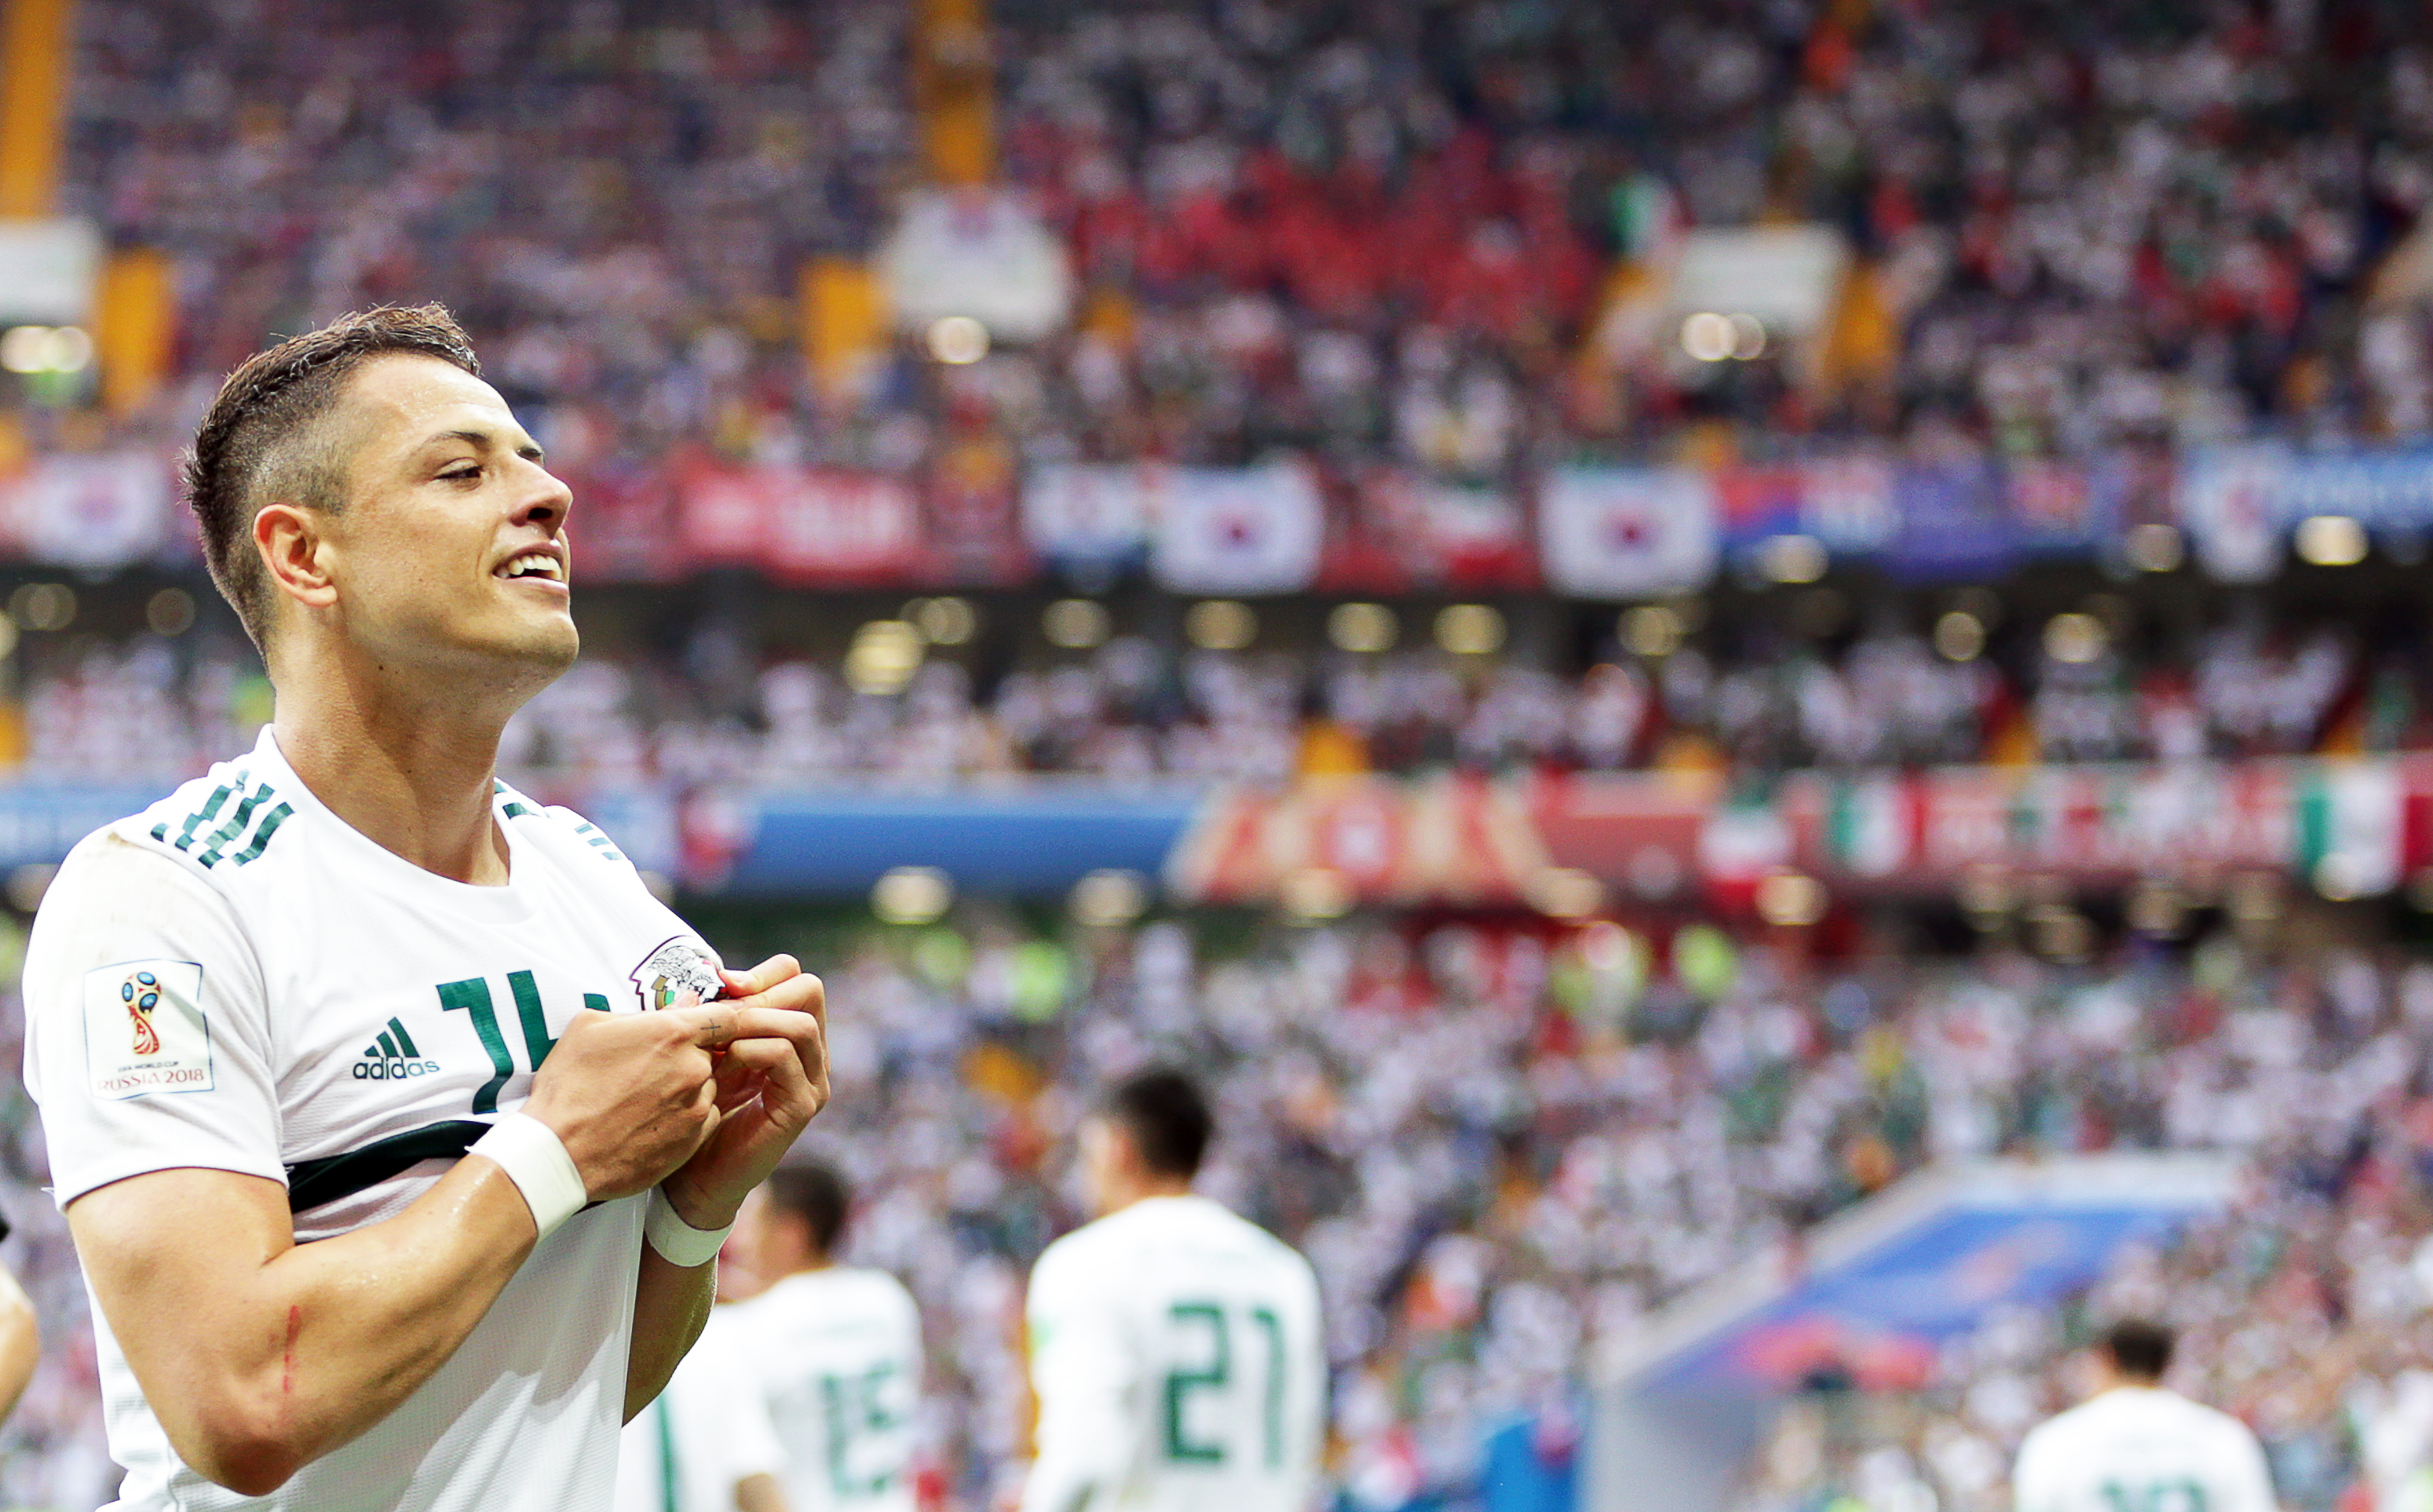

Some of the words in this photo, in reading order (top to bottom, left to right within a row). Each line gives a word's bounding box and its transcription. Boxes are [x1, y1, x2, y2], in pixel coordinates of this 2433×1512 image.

[353, 1056, 440, 1079] adidas
[97, 1072, 160, 1091] RUSSIA
[165, 1068, 204, 1083] 2018
[1164, 1300, 1285, 1471] 21
